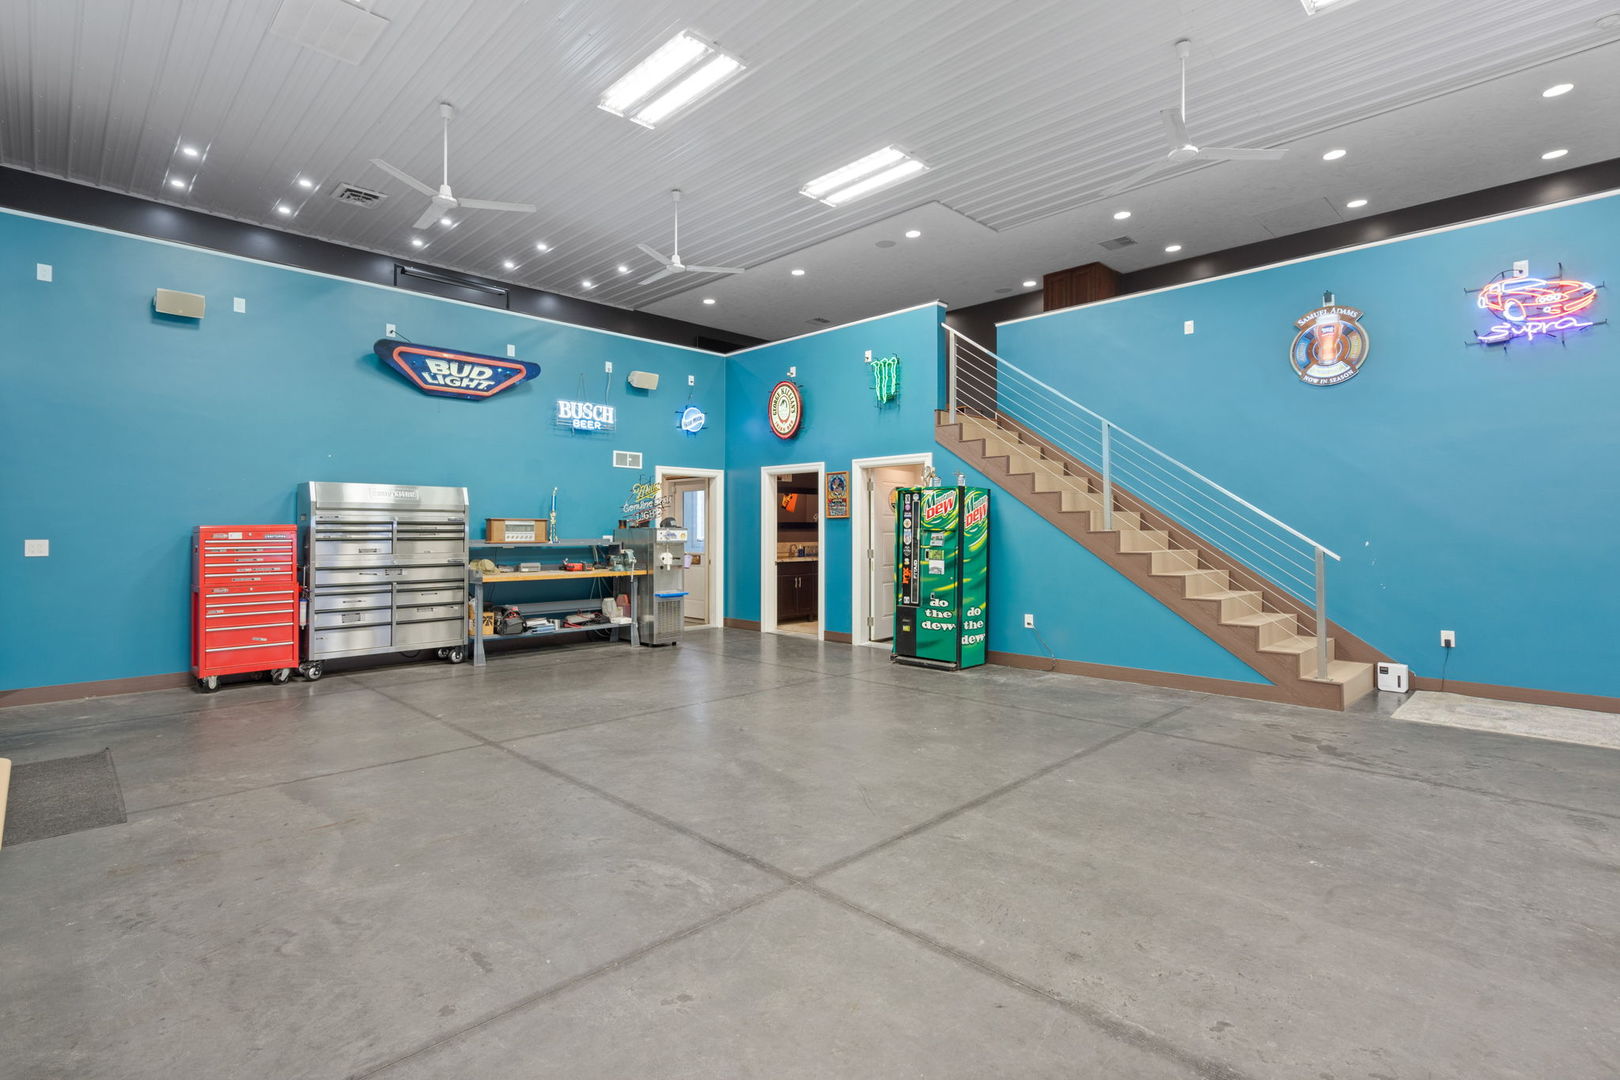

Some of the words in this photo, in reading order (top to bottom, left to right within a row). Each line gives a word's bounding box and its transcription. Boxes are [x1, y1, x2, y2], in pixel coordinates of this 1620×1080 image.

[1298, 309, 1328, 325] SAMUEL
[1330, 307, 1359, 318] ADAMS
[1477, 317, 1593, 341] Supra
[425, 358, 493, 380] BUD
[421, 372, 496, 390] LIGHT
[1303, 375, 1319, 384] NOW
[1329, 370, 1354, 382] SEASON
[772, 392, 781, 416] GEORGE
[558, 400, 615, 424] BUSCH
[572, 418, 602, 430] BEER
[929, 598, 949, 607] do
[925, 608, 953, 618] the
[967, 607, 982, 617] do
[921, 620, 957, 631] dew
[963, 620, 984, 630] the
[961, 633, 986, 645] dew
